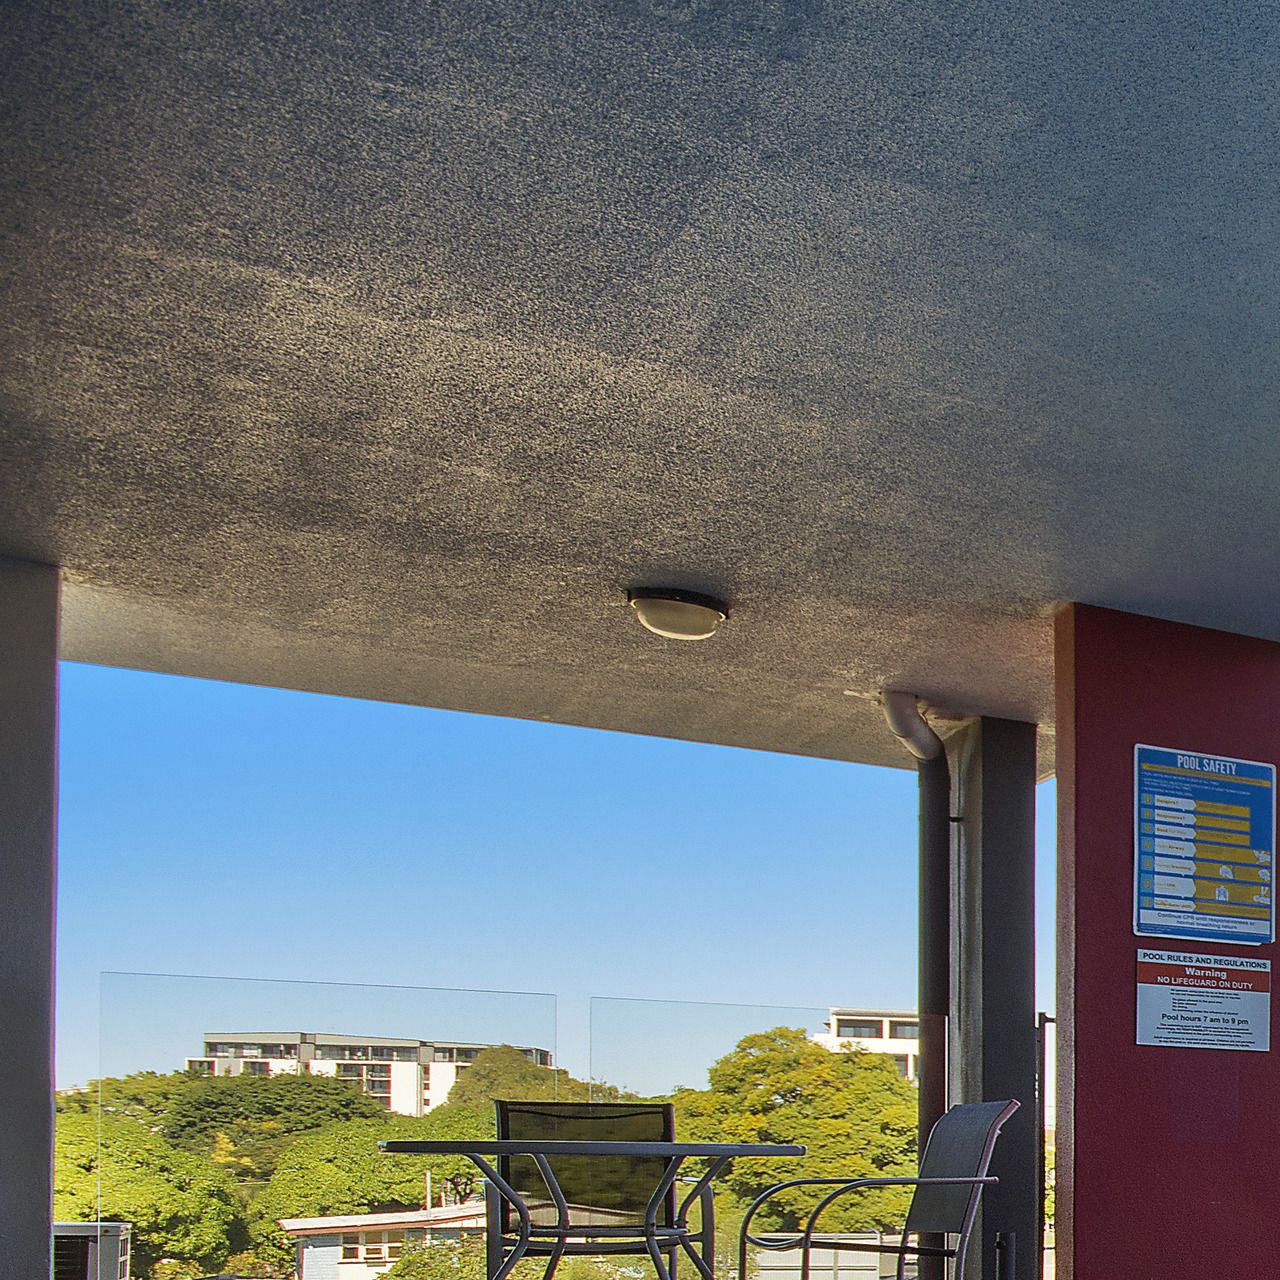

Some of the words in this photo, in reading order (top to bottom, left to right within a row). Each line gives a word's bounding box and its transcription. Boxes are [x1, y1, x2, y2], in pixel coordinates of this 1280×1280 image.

[1177, 755, 1201, 770] POOL
[1203, 759, 1237, 775] SAFETY
[1143, 952, 1165, 961] POOL
[1167, 954, 1194, 963] RULES
[1195, 956, 1212, 964] AND
[1213, 958, 1267, 969] REGULATIONS
[1185, 967, 1227, 979] Warning
[1171, 977, 1217, 987] LIFEGUARD
[1218, 980, 1230, 988] ON
[1232, 981, 1253, 989] DUTY
[1161, 1013, 1179, 1021] Pool
[1180, 1014, 1202, 1022] hours
